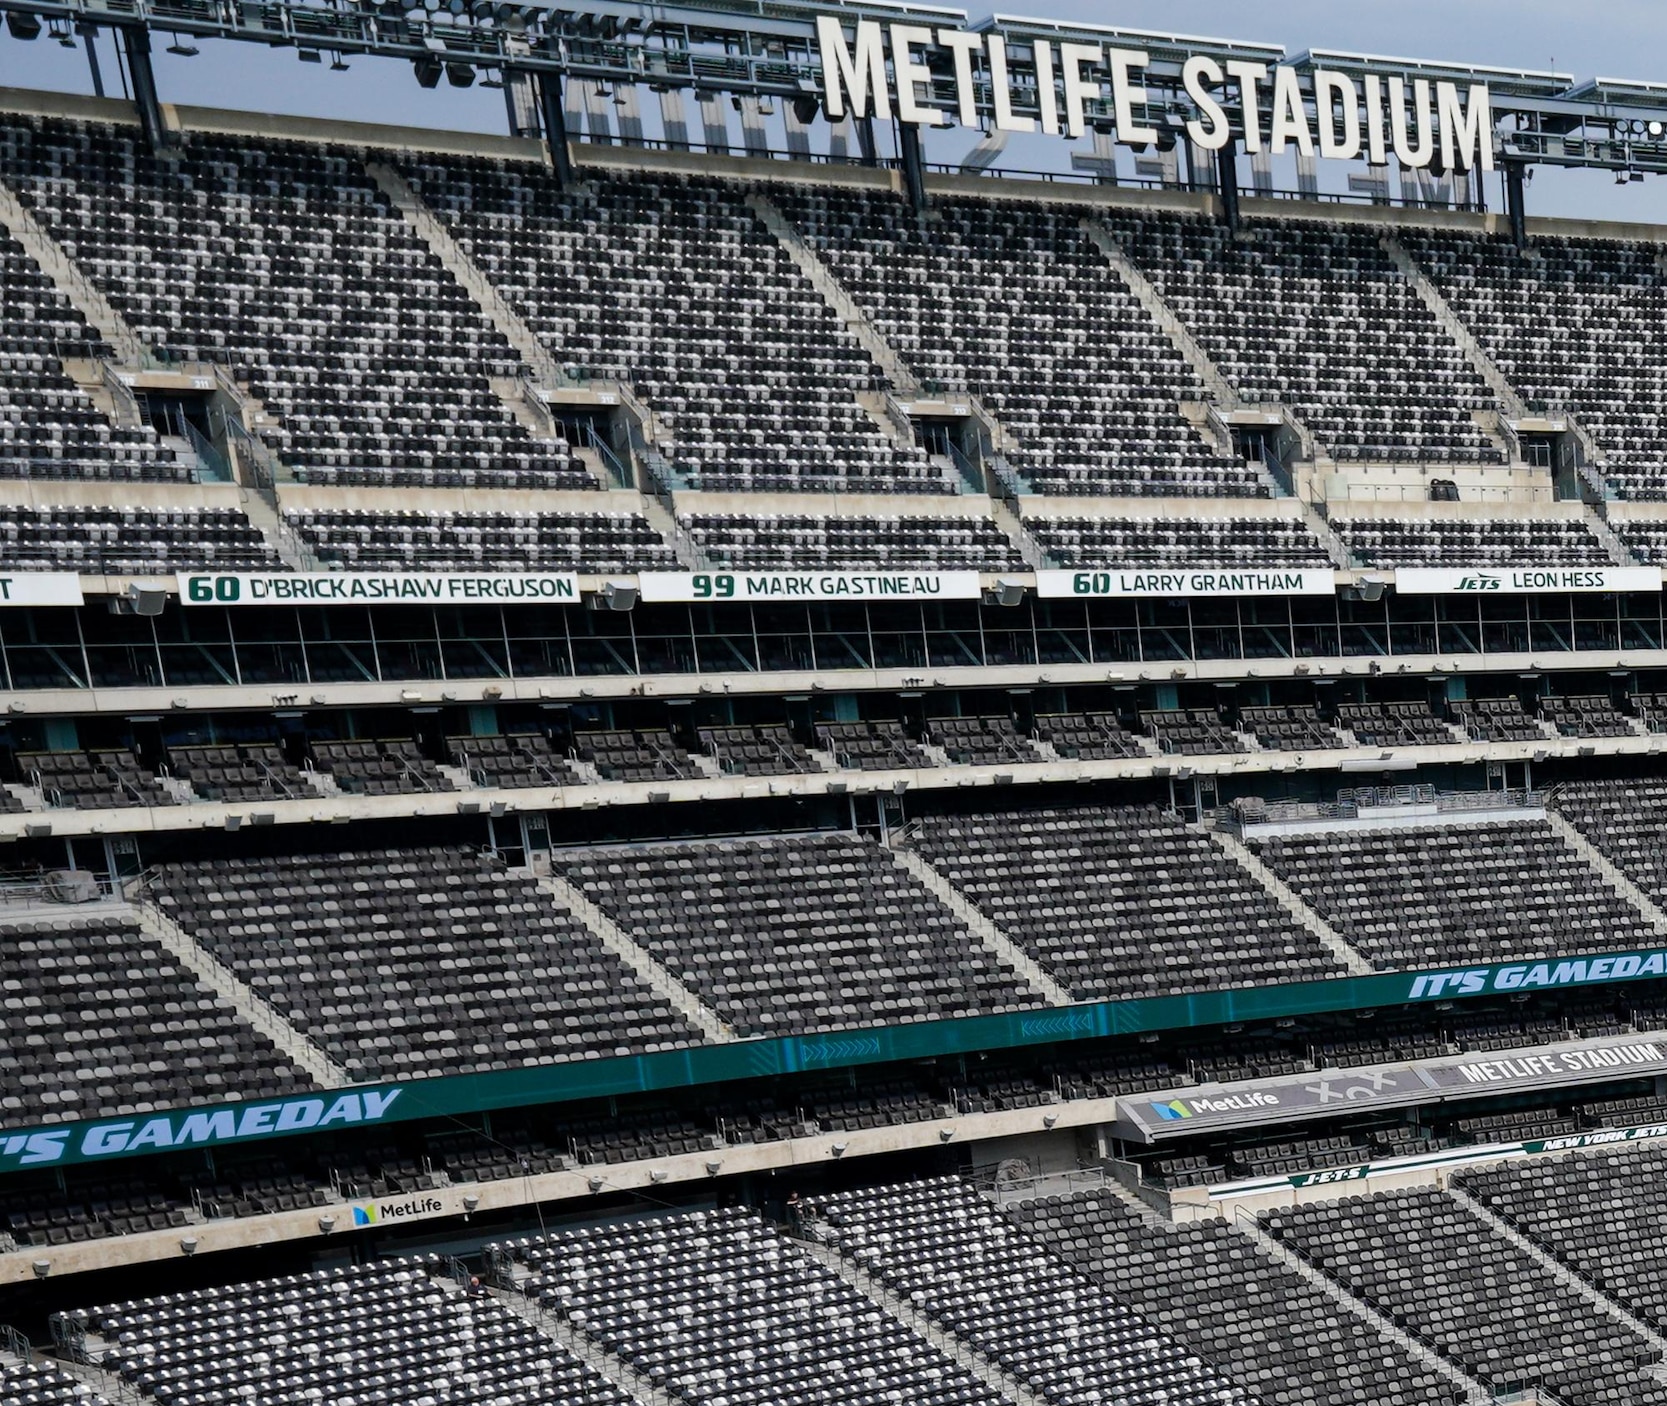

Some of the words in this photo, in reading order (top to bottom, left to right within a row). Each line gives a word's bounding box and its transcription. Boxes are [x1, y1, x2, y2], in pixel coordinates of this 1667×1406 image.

[817, 15, 1158, 144] METLIFE
[1183, 56, 1493, 170] STADIUM
[189, 577, 240, 601] 60
[250, 578, 444, 598] D'BRICKASHAW
[449, 578, 573, 598] FERGUSON
[692, 574, 734, 597] 99
[747, 577, 815, 595] MARK
[820, 577, 941, 594] GASTINEAU
[1073, 573, 1110, 594] 60
[1121, 575, 1185, 591] LARRY
[1191, 574, 1303, 591] GRANTHAM
[1454, 574, 1502, 590] JETS
[1513, 573, 1558, 587] LEON
[1562, 573, 1604, 586] HESS
[1408, 970, 1489, 998] IT'S
[1458, 1055, 1562, 1083] METLIFE
[1560, 1043, 1664, 1070] STADIUM
[1190, 1092, 1280, 1113] MetLife
[81, 1089, 403, 1156] GAMEDAY
[1543, 1136, 1582, 1151] NEW
[1581, 1130, 1629, 1146] YORK
[381, 1199, 442, 1218] MetLife
